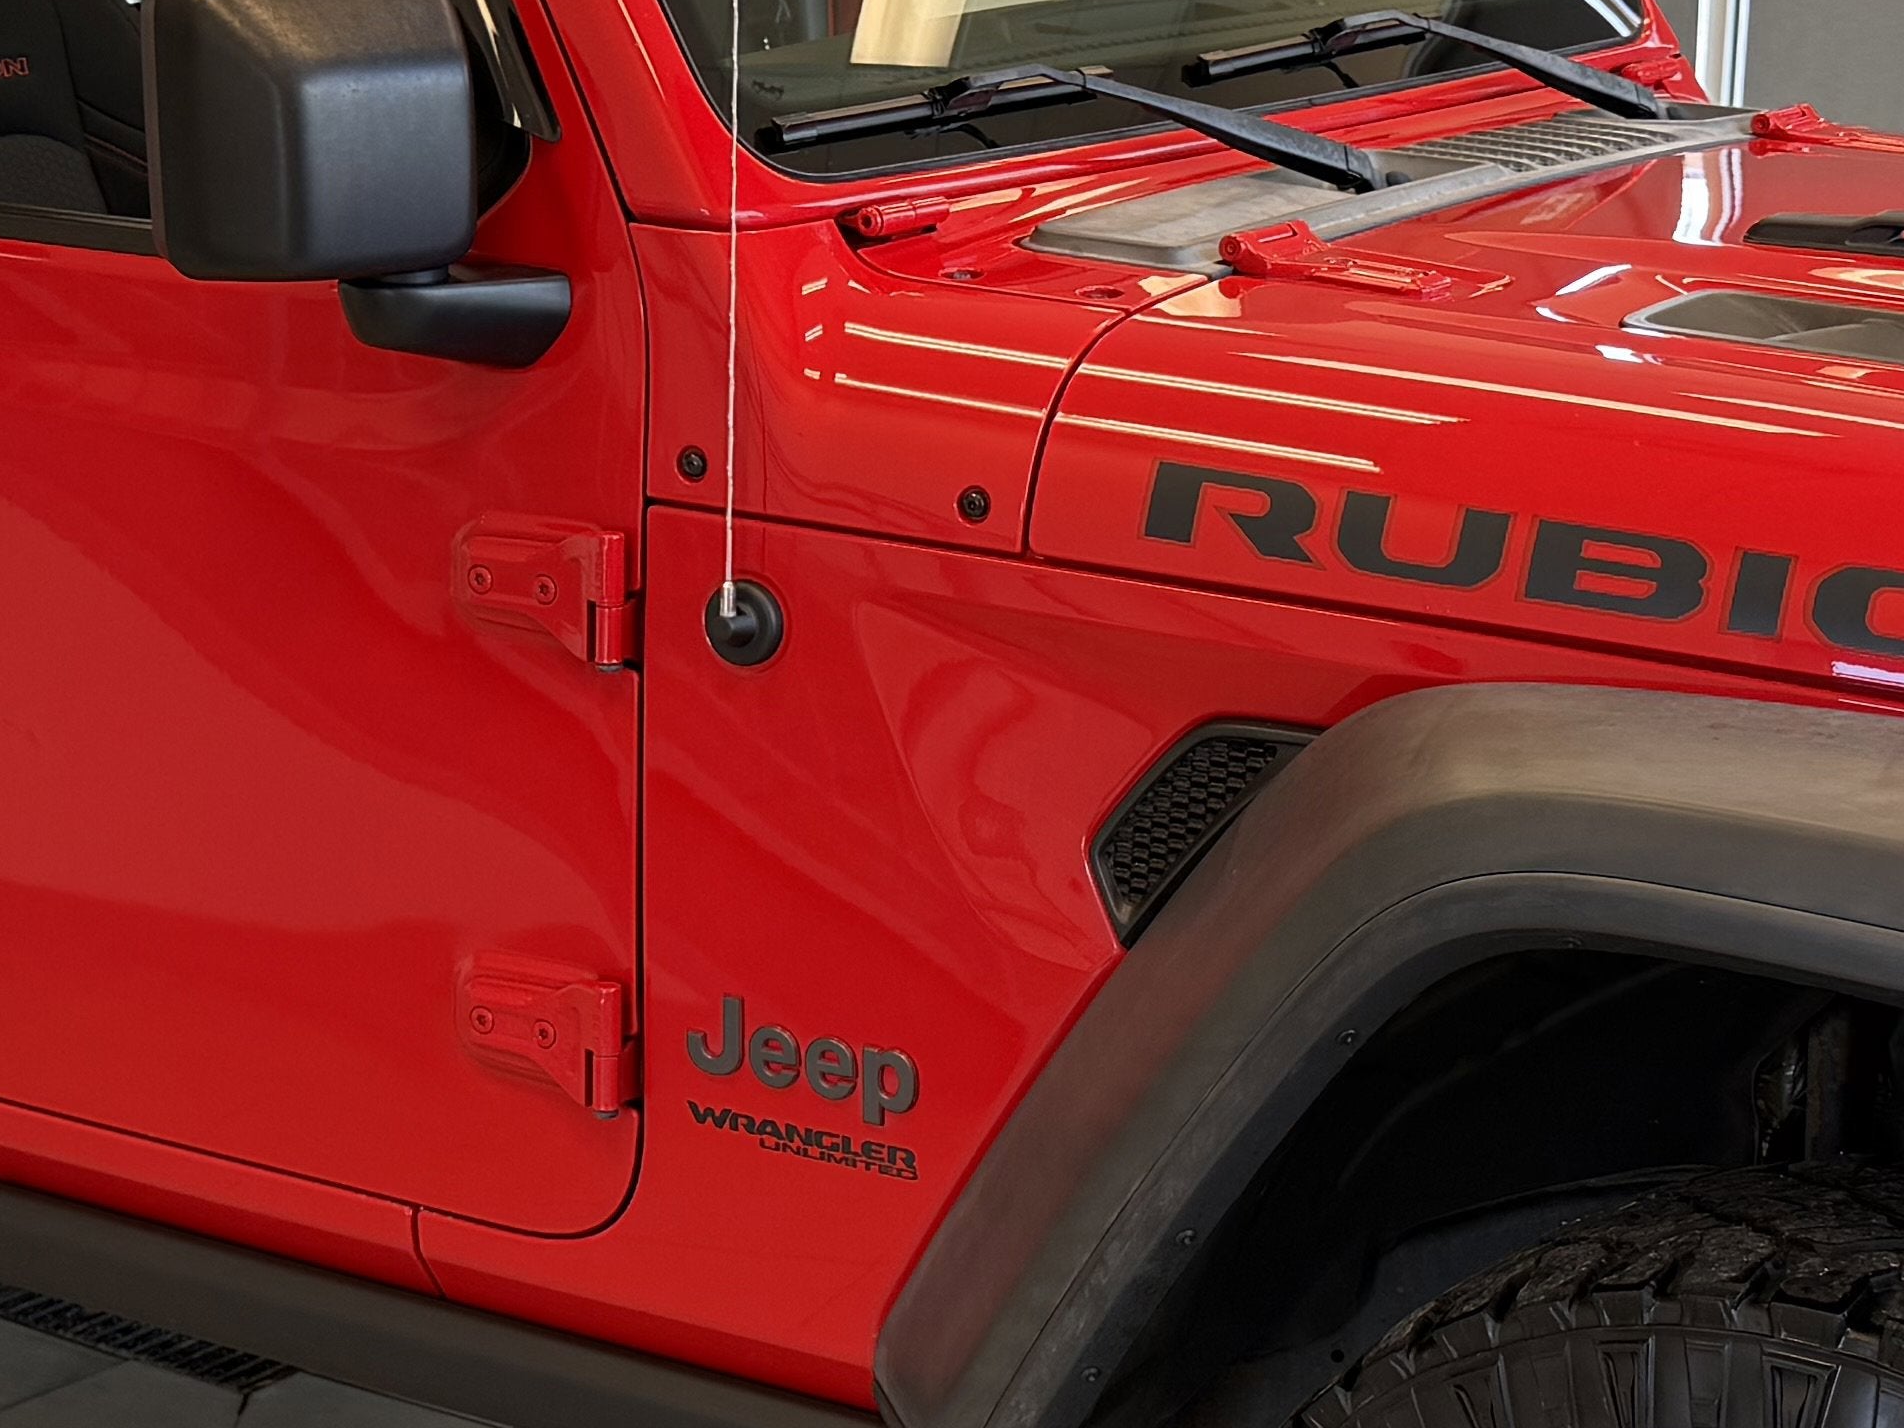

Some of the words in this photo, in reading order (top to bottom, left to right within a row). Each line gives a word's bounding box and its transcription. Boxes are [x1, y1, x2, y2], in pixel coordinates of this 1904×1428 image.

[686, 993, 920, 1126] Jeep
[686, 1099, 918, 1170] WRANGLER
[758, 1137, 919, 1181] UNLIMITED
